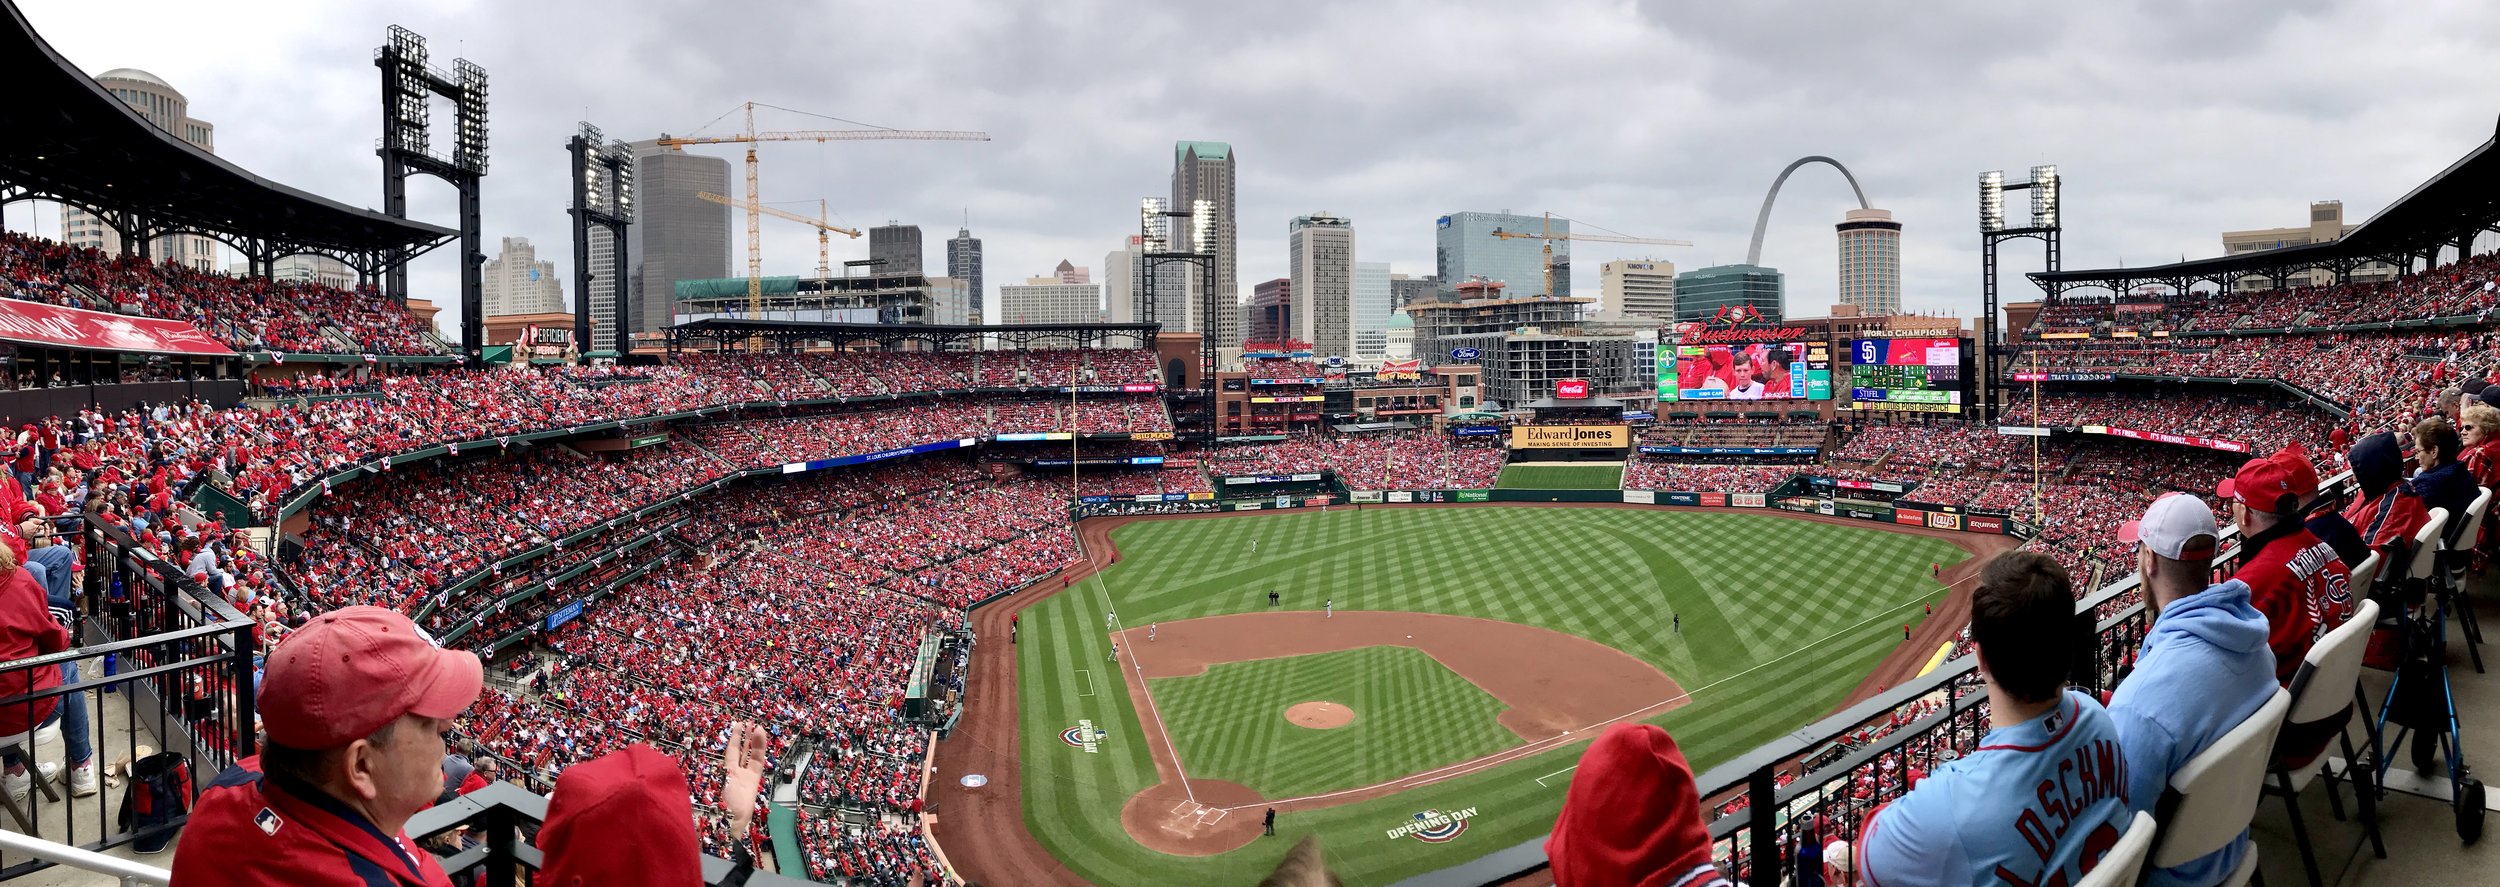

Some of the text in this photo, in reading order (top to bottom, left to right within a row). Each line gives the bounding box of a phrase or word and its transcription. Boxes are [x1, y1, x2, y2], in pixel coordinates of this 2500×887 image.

[529, 324, 568, 344] PERFICIENT
[1675, 322, 1806, 345] Budweiser
[1863, 329, 1948, 337] WORLD CHAMPIONS
[536, 346, 559, 355] PERCH
[1243, 337, 1313, 352] Cardinals Nation
[1457, 350, 1475, 358] Ford
[1380, 361, 1418, 373] Budweiser
[1376, 372, 1421, 380] BREW HOUSE
[1560, 385, 1584, 393] Coca-Cola
[1859, 389, 1879, 398] STIFEL
[1873, 402, 1881, 410] ST.
[1883, 402, 1901, 410] LOUIS
[1901, 403, 1949, 412] POST-DISPATCH
[1527, 428, 1612, 440] Edward Jones
[2150, 432, 2190, 445] IT'S FRIENDLY...
[1932, 512, 1955, 526] Lay's
[1970, 520, 1999, 528] EQUIFAX
[2285, 546, 2325, 582] WORLD
[1079, 719, 1099, 753] OPENING DAY
[1386, 806, 1478, 840] OPENING DAY
